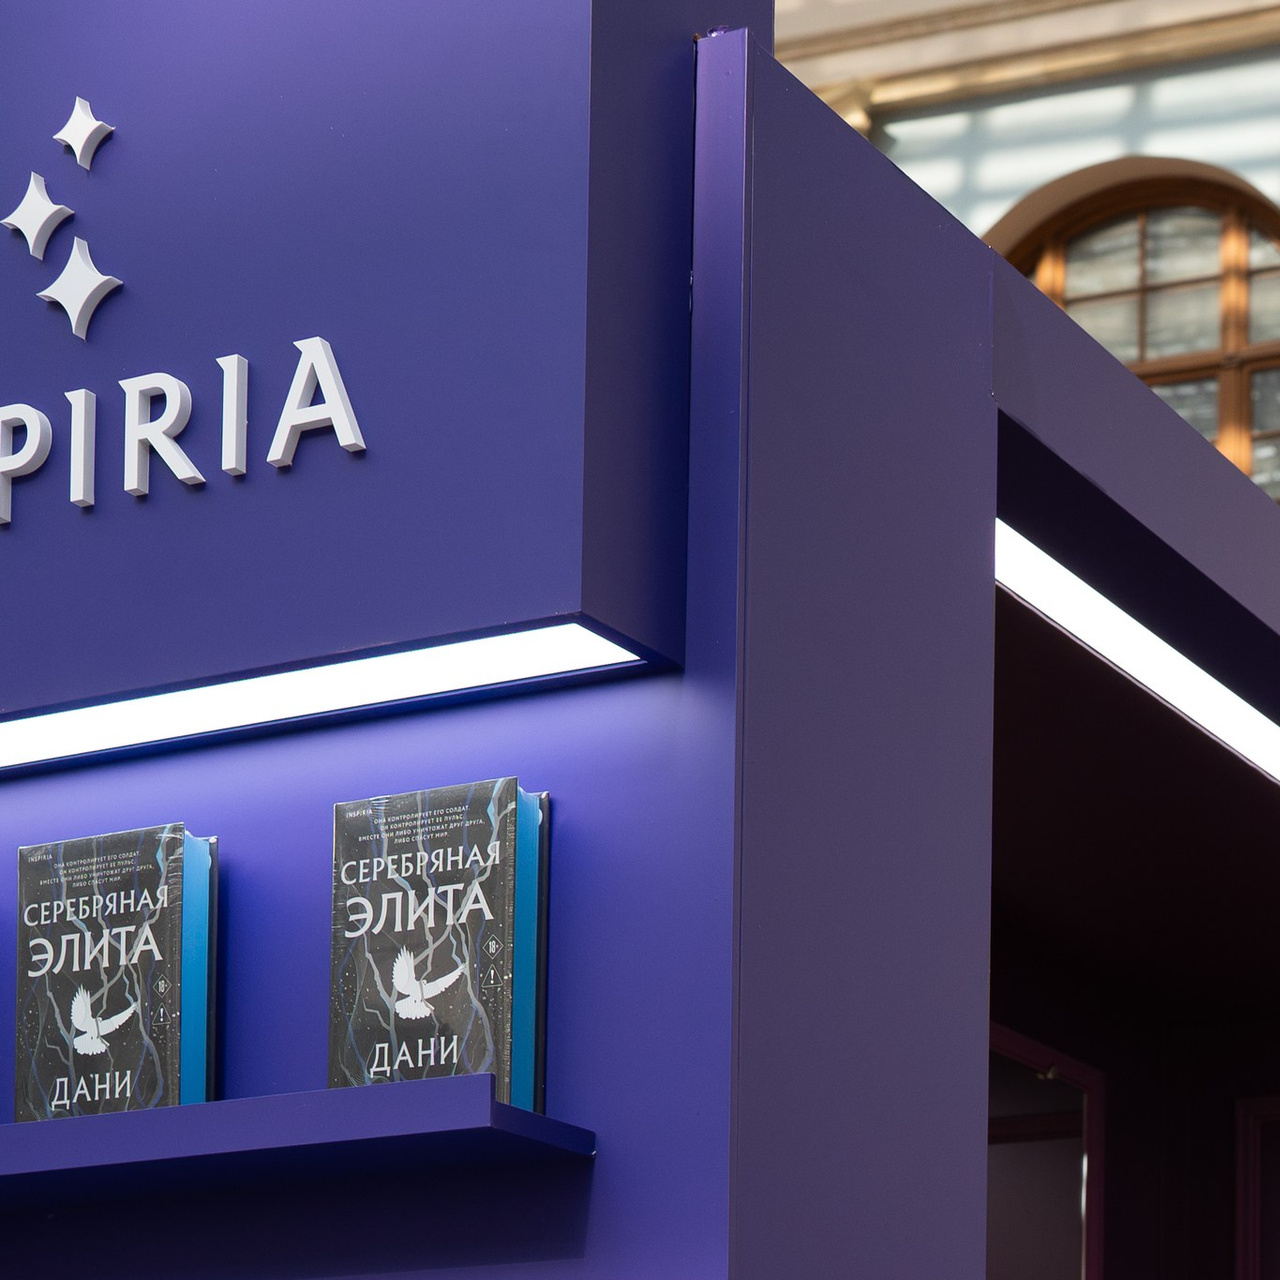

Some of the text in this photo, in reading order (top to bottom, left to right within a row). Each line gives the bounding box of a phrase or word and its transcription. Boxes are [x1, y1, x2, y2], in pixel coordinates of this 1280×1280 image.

[346, 810, 372, 818] INSPIRIA
[28, 854, 52, 862] INSPIRIA
[340, 841, 501, 885] СЕРЕБРЯНАЯ
[24, 885, 168, 927] СЕРЕБРЯНАЯ
[345, 880, 494, 939] ЭЛИТА
[28, 922, 163, 977] ЭЛИТА
[488, 940, 499, 954] 18+
[370, 1035, 458, 1079] ДАНИ
[52, 1070, 131, 1111] ДАНИ
